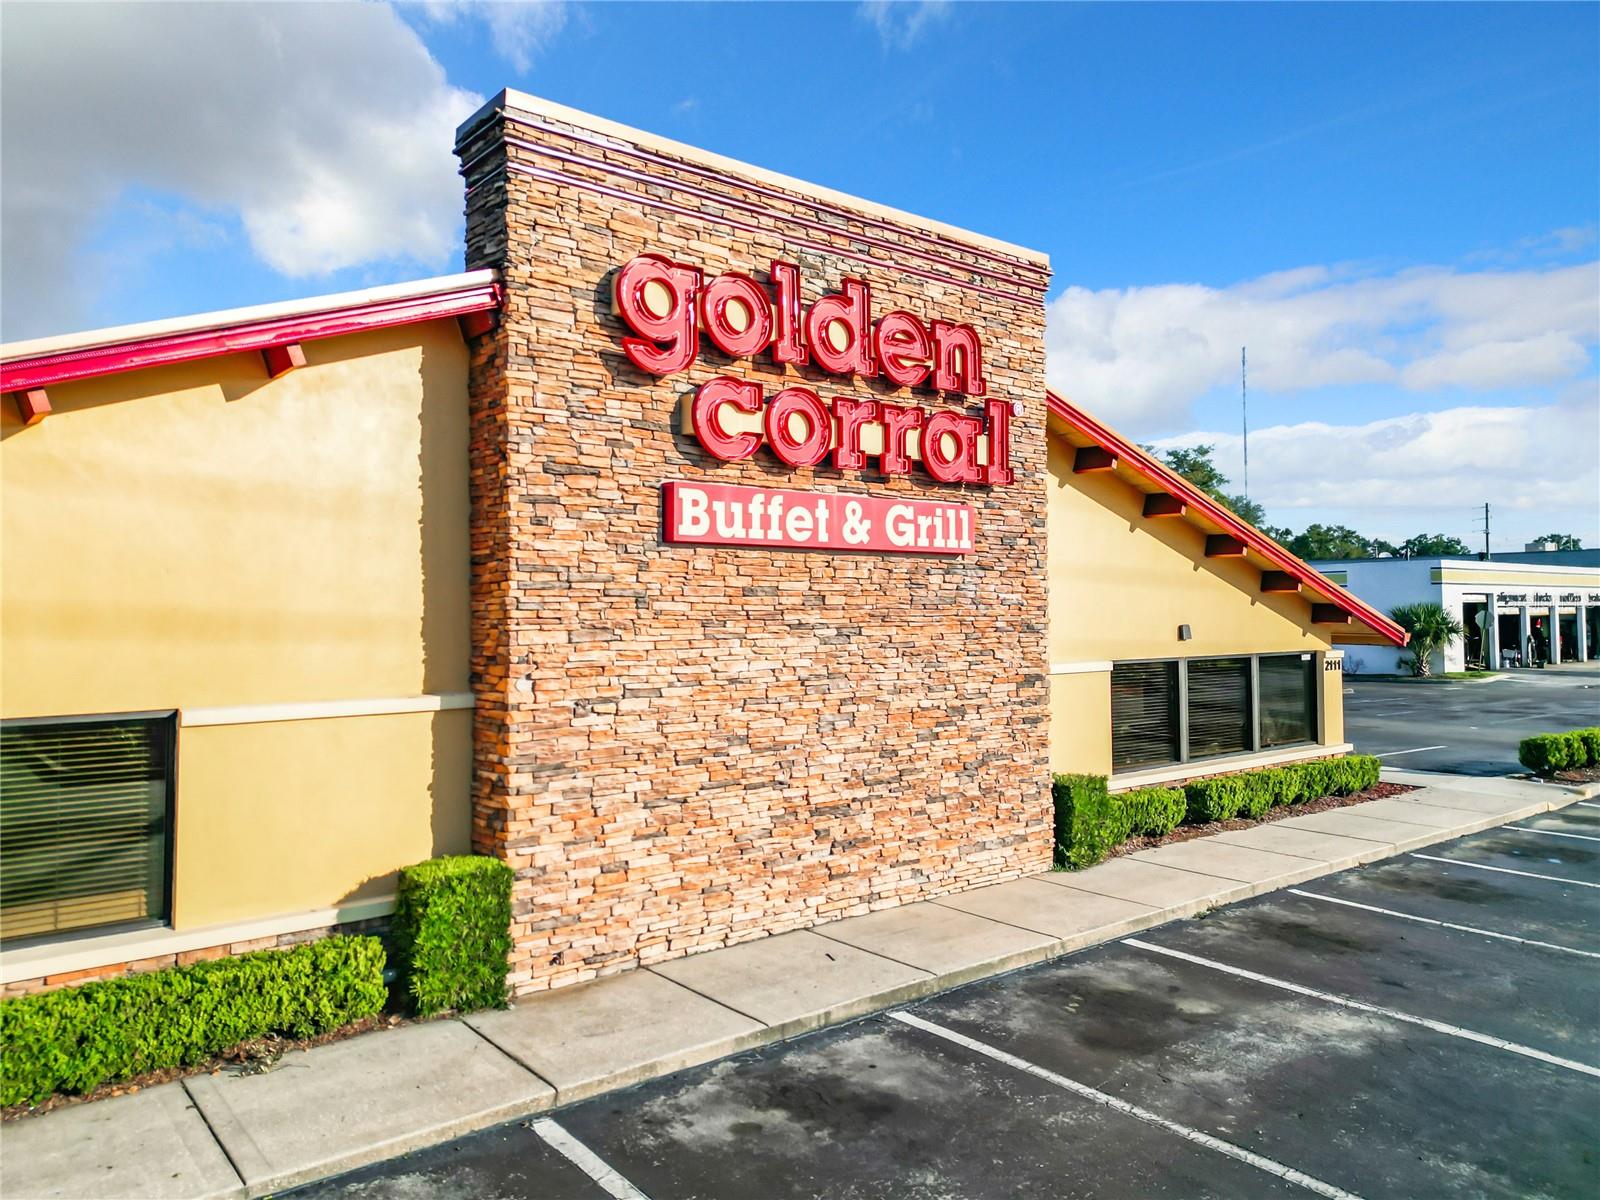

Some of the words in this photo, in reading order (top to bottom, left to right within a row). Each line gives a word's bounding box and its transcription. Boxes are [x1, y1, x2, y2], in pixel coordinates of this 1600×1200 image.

[615, 253, 987, 396] golden
[692, 376, 1015, 485] corral
[677, 487, 830, 543] Buffet
[841, 501, 872, 545] &
[884, 504, 972, 549] Grill
[1324, 659, 1341, 671] 2111
